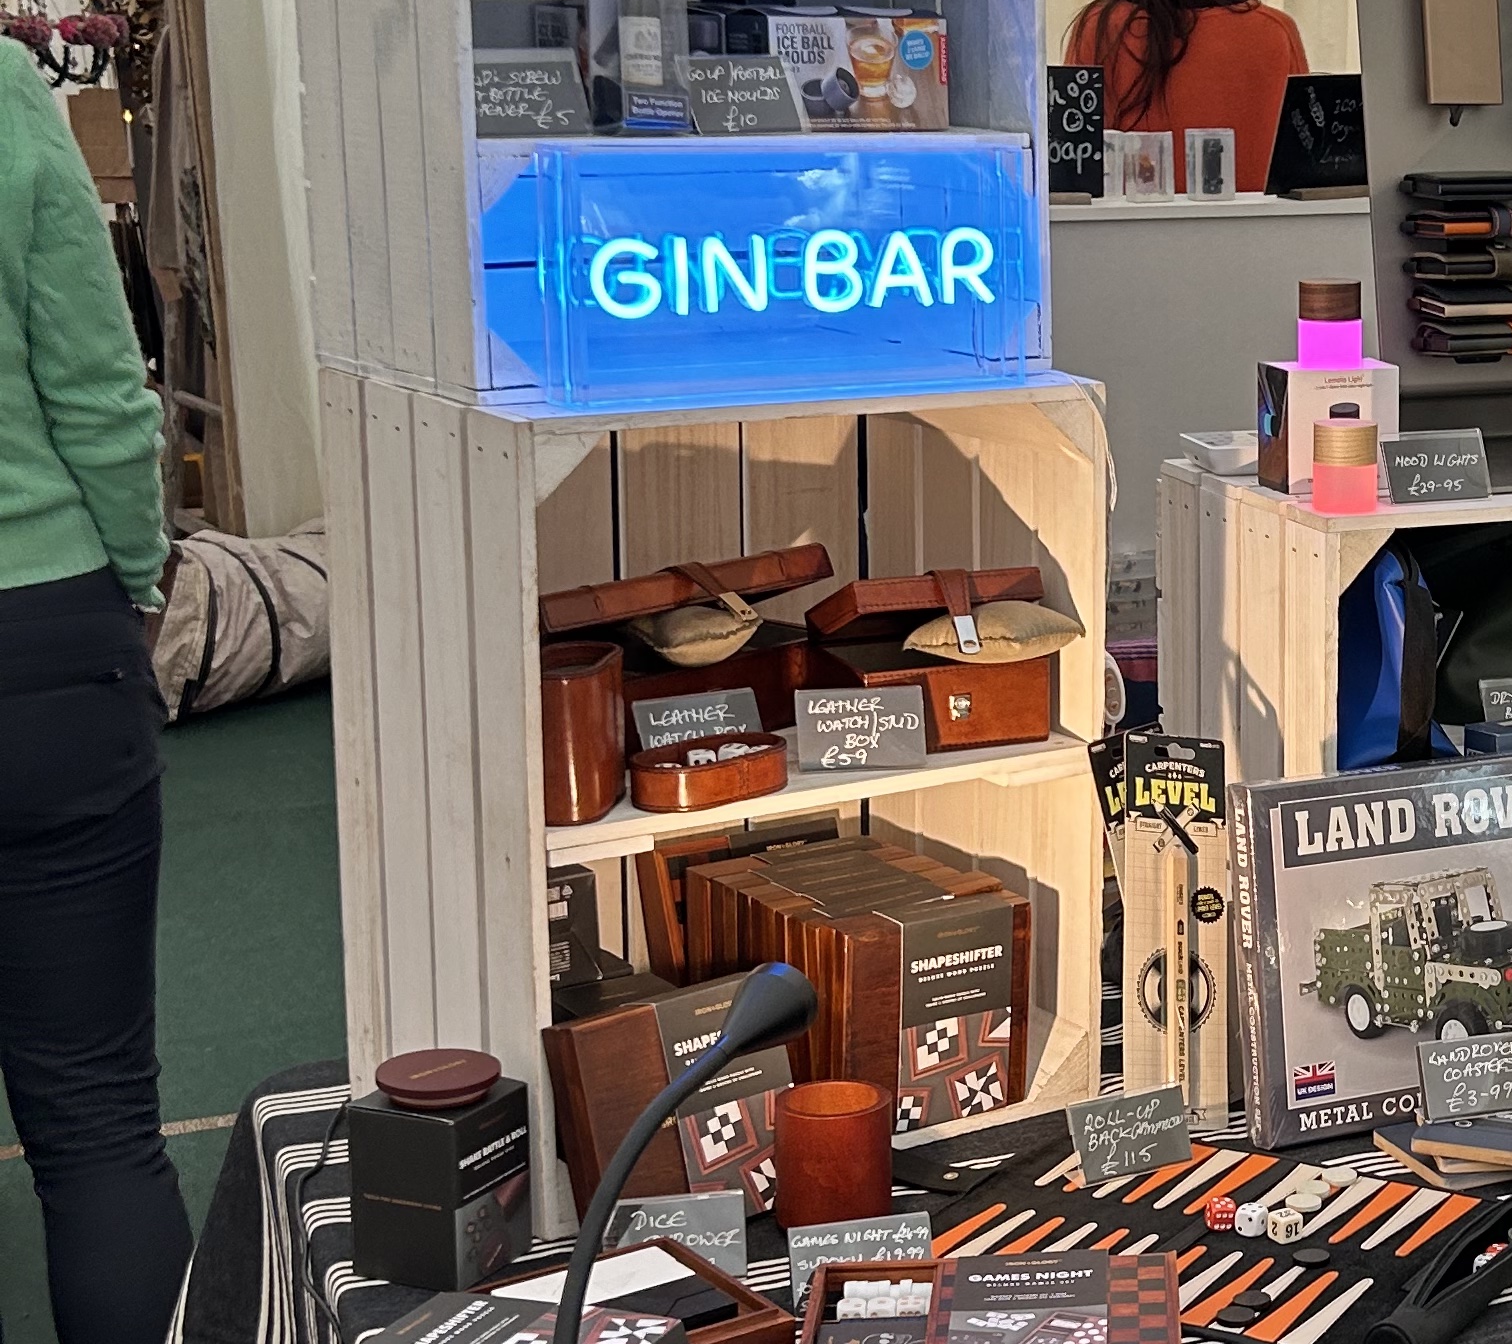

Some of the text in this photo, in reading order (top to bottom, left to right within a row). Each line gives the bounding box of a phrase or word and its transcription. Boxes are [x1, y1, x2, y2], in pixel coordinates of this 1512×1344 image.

[776, 23, 826, 35] FOOTBALL
[777, 36, 834, 50] ICE BALL
[777, 50, 825, 65] MOLDS
[533, 100, 575, 129] £5
[722, 106, 758, 133] £10
[589, 226, 997, 319] GIN BAR
[1395, 454, 1479, 467] MOOD LIGHTS
[650, 704, 735, 727] LEATHER
[808, 696, 885, 714] LEATHER
[844, 733, 880, 749] BOX
[821, 745, 868, 768] £59
[1145, 761, 1205, 777] CARPENTERS
[1135, 777, 1216, 813] LEVEL
[1234, 807, 1249, 868] LAND
[1295, 796, 1418, 856] LAND
[1238, 874, 1254, 950] ROVER
[910, 944, 1003, 975] SHAPESHIFTER
[1297, 1082, 1334, 1096] UK DESIGN
[1083, 1098, 1161, 1136] ROLL-UP
[1299, 1101, 1373, 1132] METAL
[1101, 1143, 1158, 1176] £115
[631, 1210, 687, 1231] DICE
[791, 1228, 893, 1249] GAMES NIGHT
[968, 1269, 1094, 1282] GAMES NIGHT
